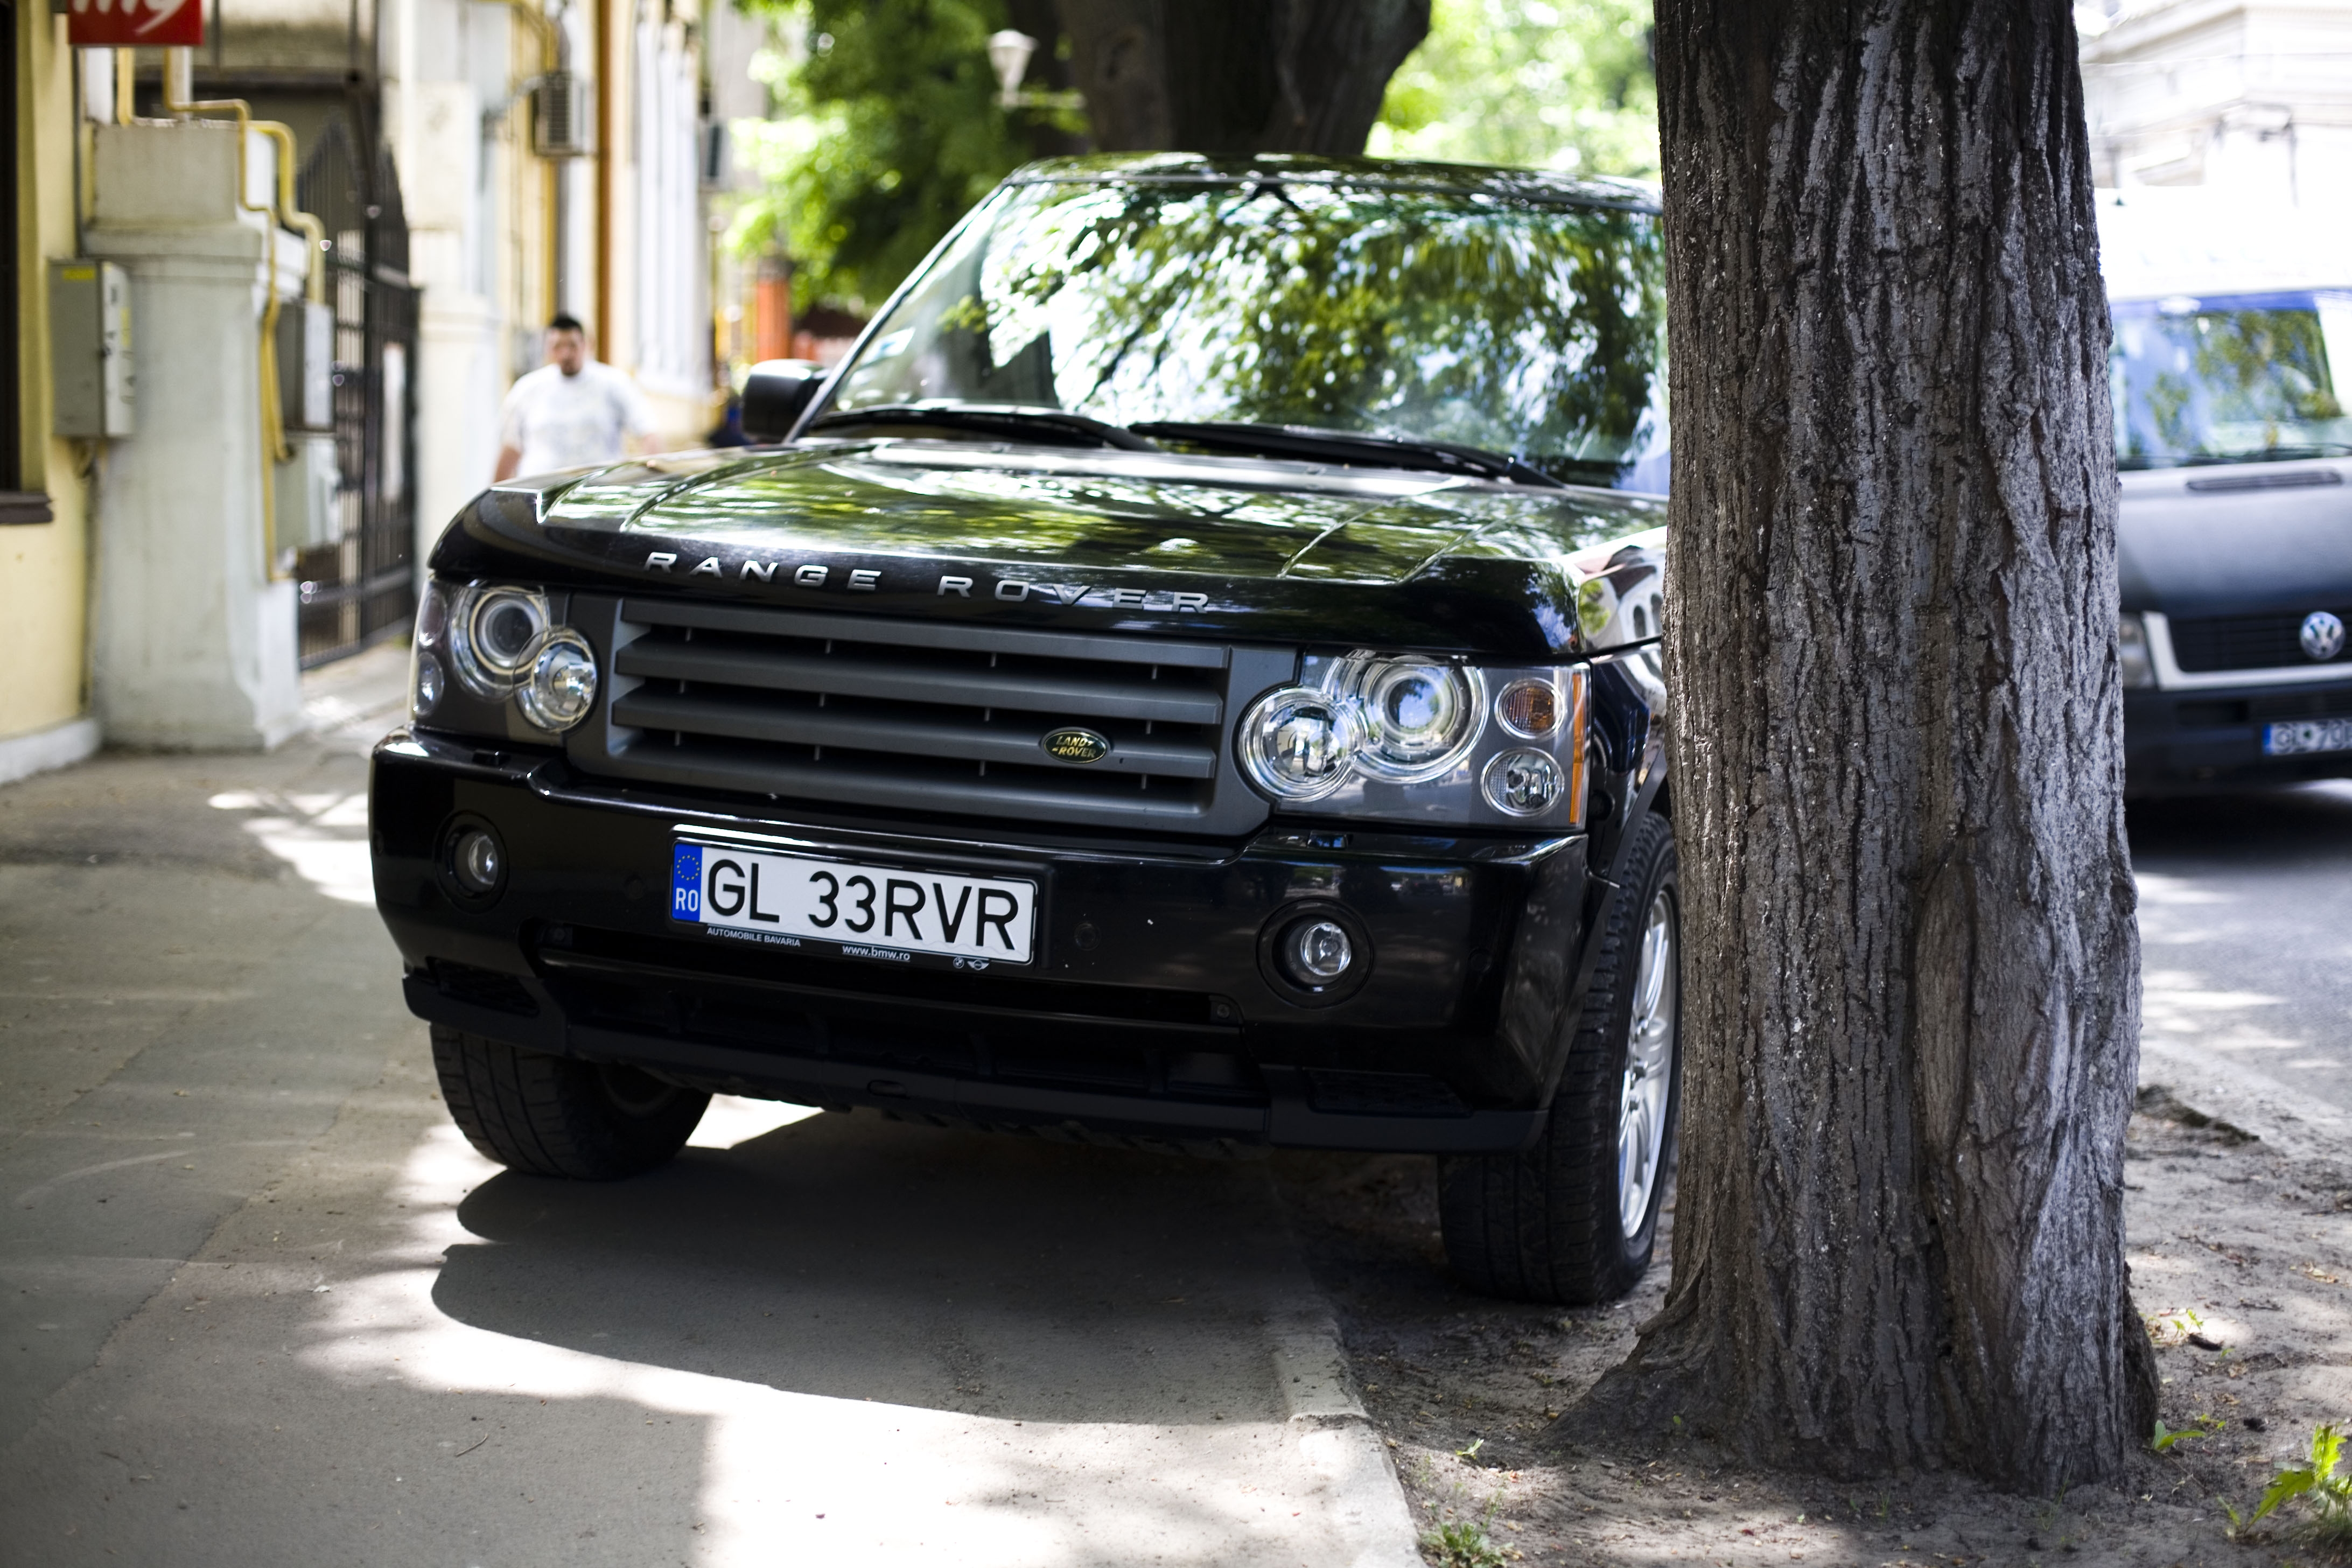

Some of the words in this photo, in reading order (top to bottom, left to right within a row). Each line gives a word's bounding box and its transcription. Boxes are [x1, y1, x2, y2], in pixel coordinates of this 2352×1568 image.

[645, 552, 881, 591] RANGE
[937, 576, 1208, 613] ROVER
[1056, 736, 1088, 747] LAND
[1058, 746, 1096, 758] ROVER
[675, 887, 698, 912] RO
[708, 859, 779, 923] GL
[808, 871, 1019, 950] 33RVR
[707, 927, 762, 942] AUTOMOBILE
[764, 935, 801, 947] BAVARIA
[842, 945, 911, 961] www.bmw.ro
